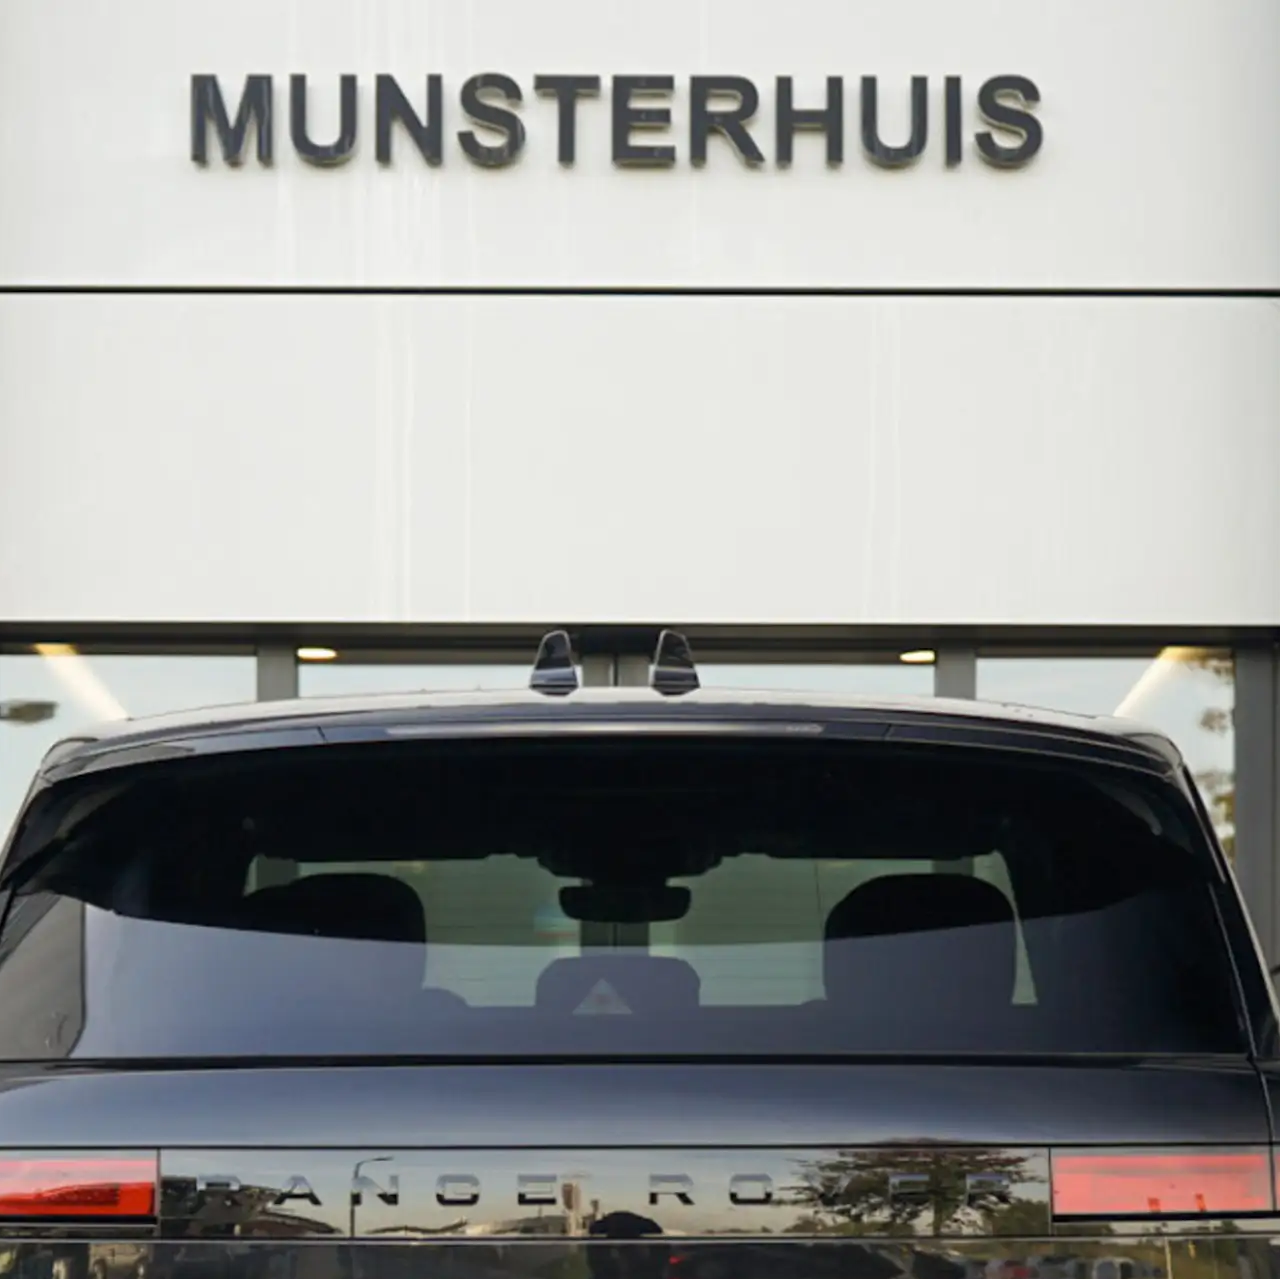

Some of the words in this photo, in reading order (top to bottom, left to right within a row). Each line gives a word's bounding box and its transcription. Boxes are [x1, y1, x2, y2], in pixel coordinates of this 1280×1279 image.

[191, 74, 1043, 168] MUNSTERHUIS
[196, 1174, 557, 1206] RANGE
[649, 1173, 1013, 1206] ROVER
